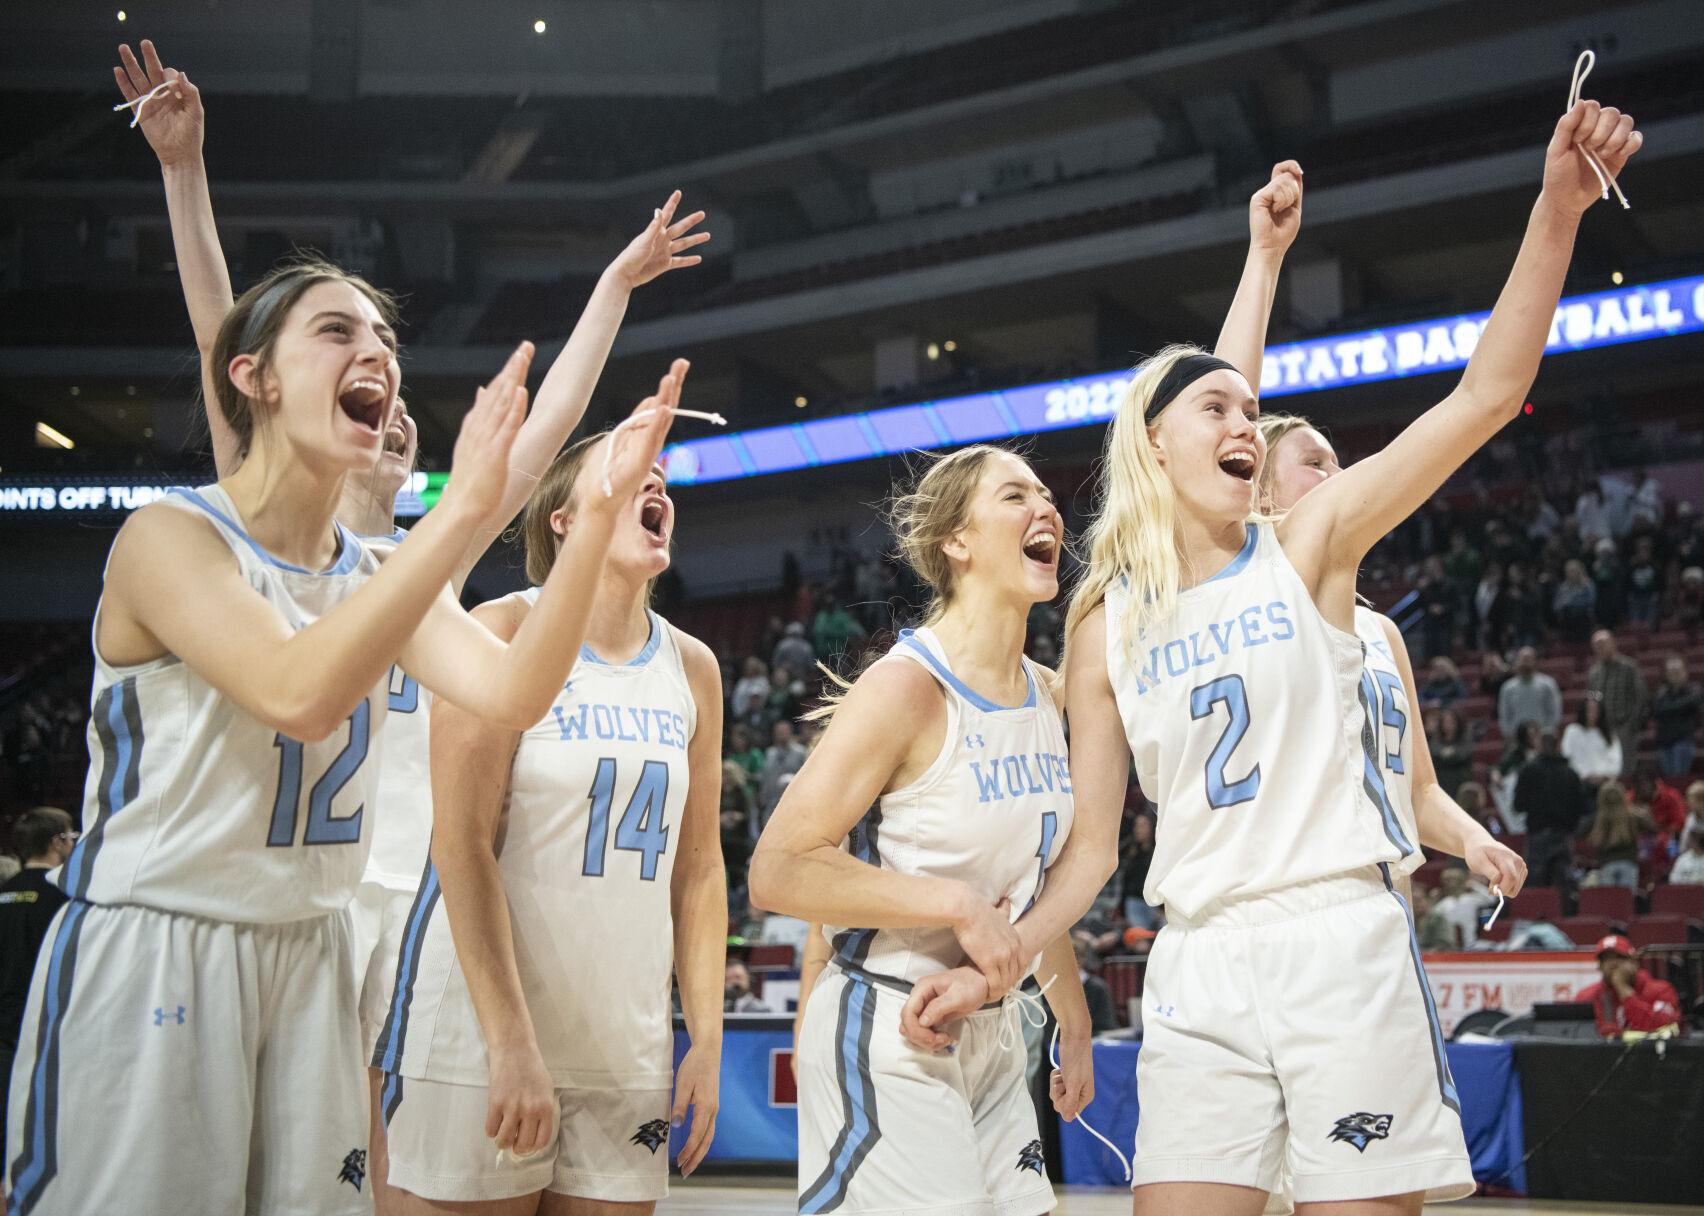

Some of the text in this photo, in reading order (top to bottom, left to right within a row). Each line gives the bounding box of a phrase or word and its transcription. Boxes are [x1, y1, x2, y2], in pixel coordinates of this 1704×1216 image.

[1261, 336, 1389, 388] STATE
[1395, 287, 1684, 370] BASTBALL
[0, 487, 57, 510] INTS
[58, 486, 107, 510] OFF
[266, 697, 371, 848] 12
[552, 704, 686, 751] WOLVES
[1189, 673, 1262, 811] 2
[581, 757, 670, 882] 14
[1461, 981, 1503, 1011] FM
